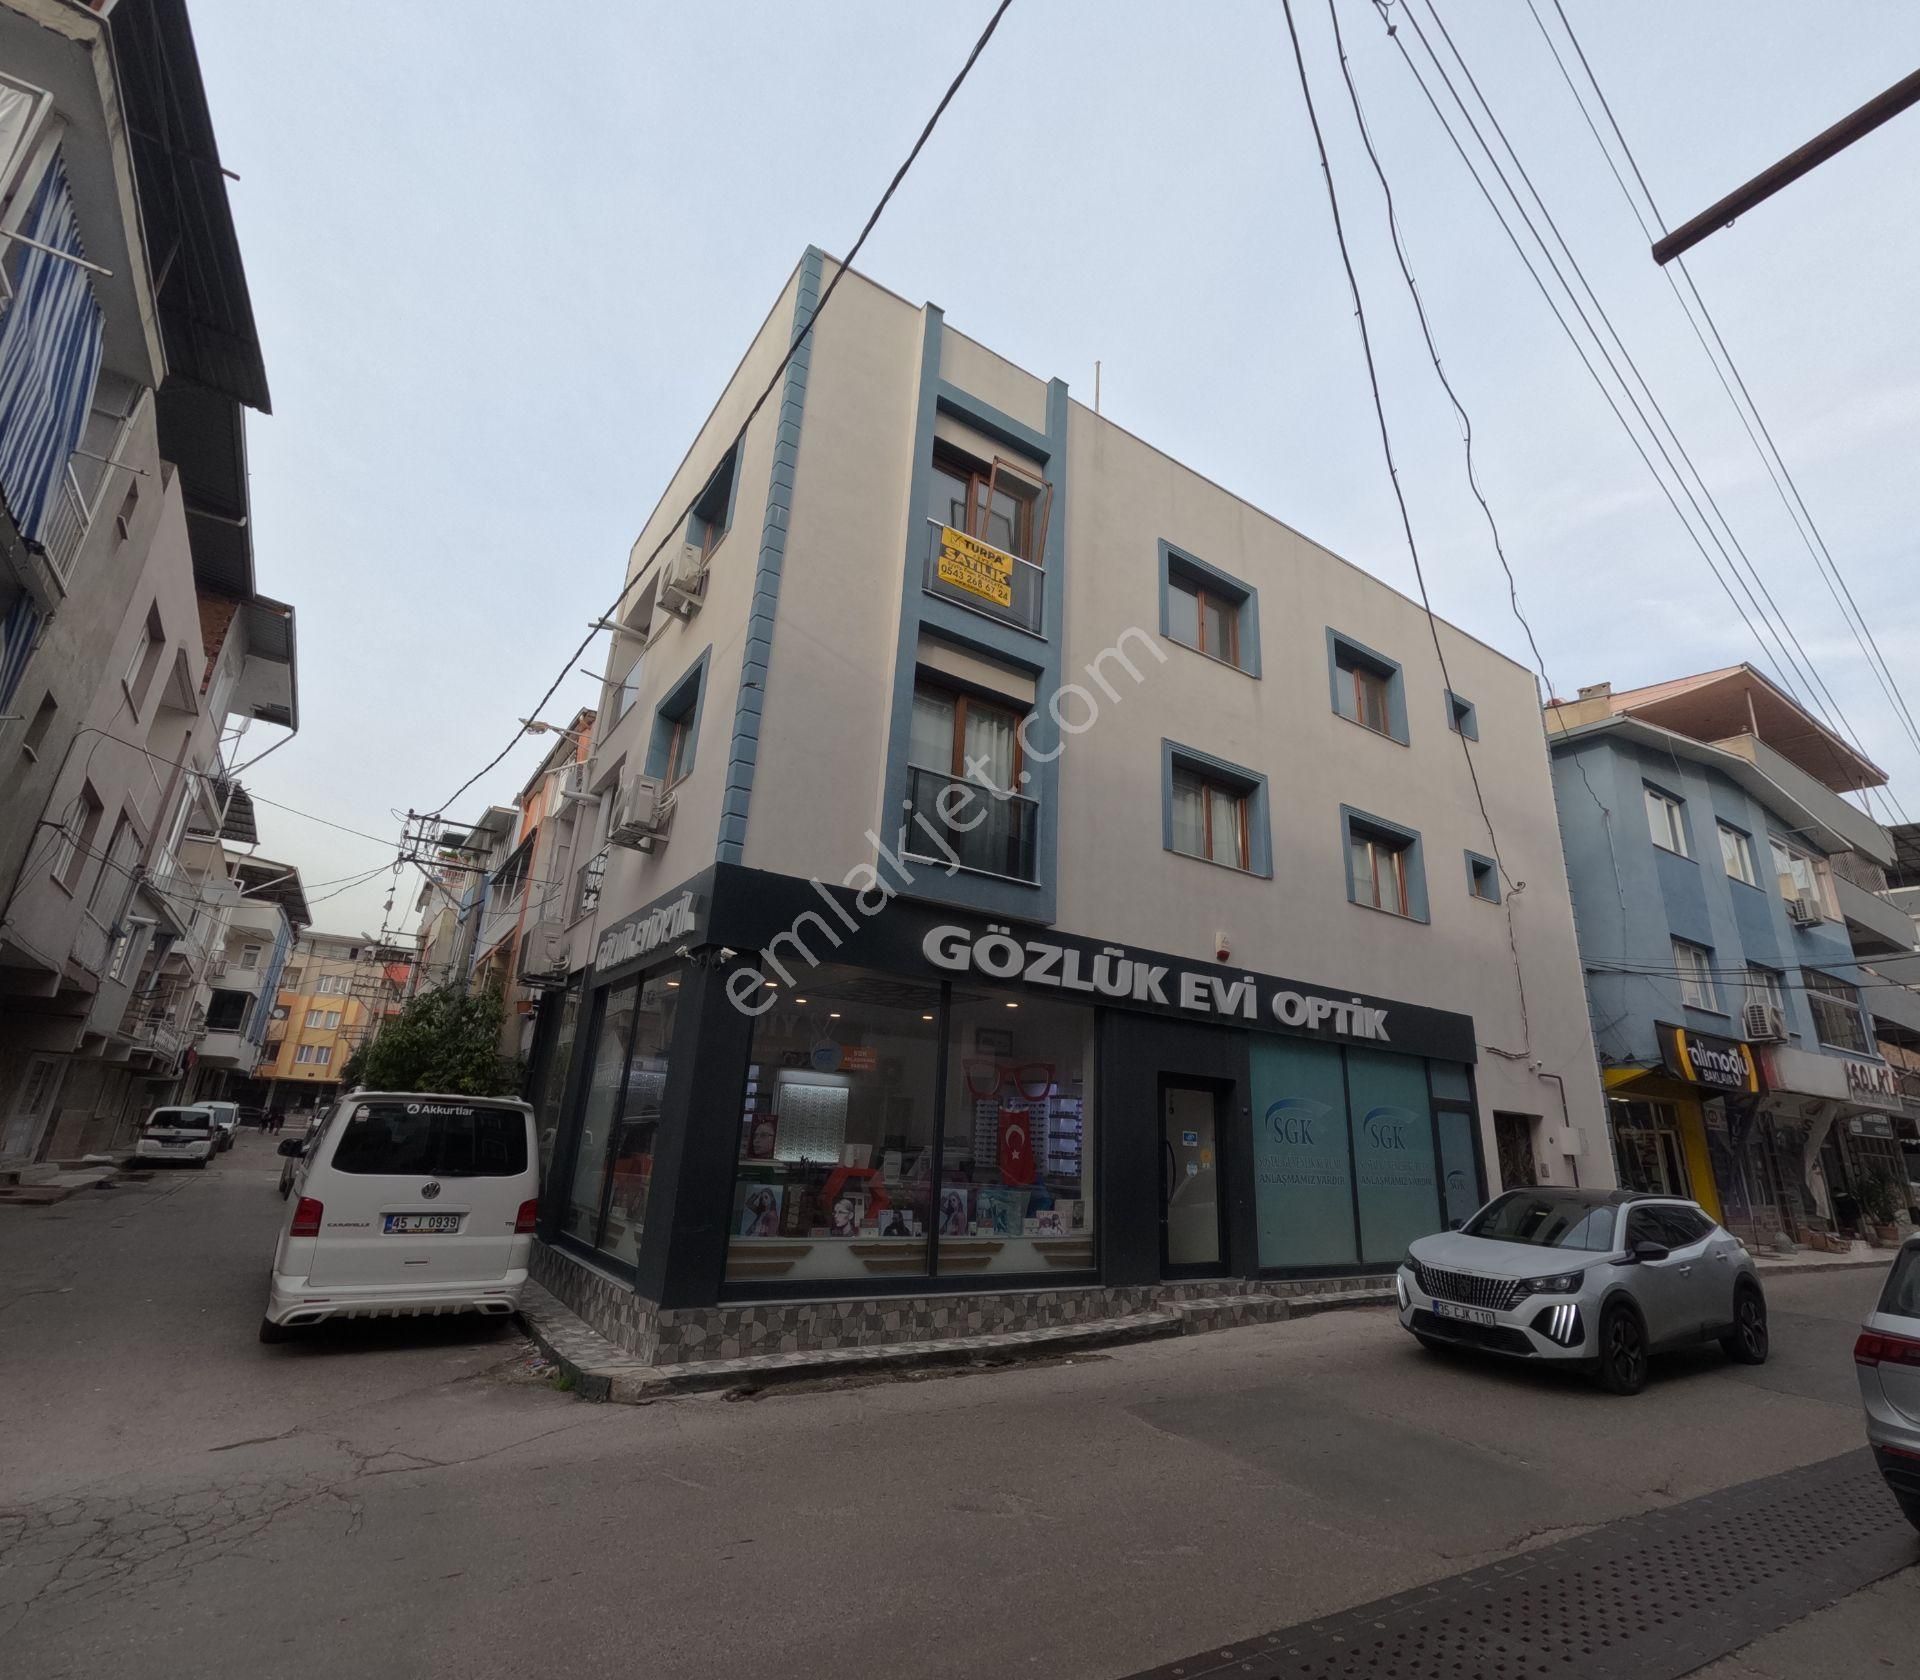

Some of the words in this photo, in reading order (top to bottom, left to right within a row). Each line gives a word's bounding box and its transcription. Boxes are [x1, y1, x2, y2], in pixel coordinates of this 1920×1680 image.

[964, 539, 1003, 566] TURPA
[941, 564, 964, 580] 0543
[944, 547, 1010, 586] SATILIK
[922, 924, 1170, 1005] GÖZLÜK
[1180, 971, 1258, 1019] EVİ
[1272, 990, 1391, 1042] OPTİK
[421, 1104, 475, 1116] Akkurtlar
[1274, 1117, 1314, 1145] SGK
[1371, 1124, 1406, 1150] SGK
[393, 1216, 409, 1229] 45
[414, 1216, 423, 1228] J
[428, 1216, 458, 1228] 0939
